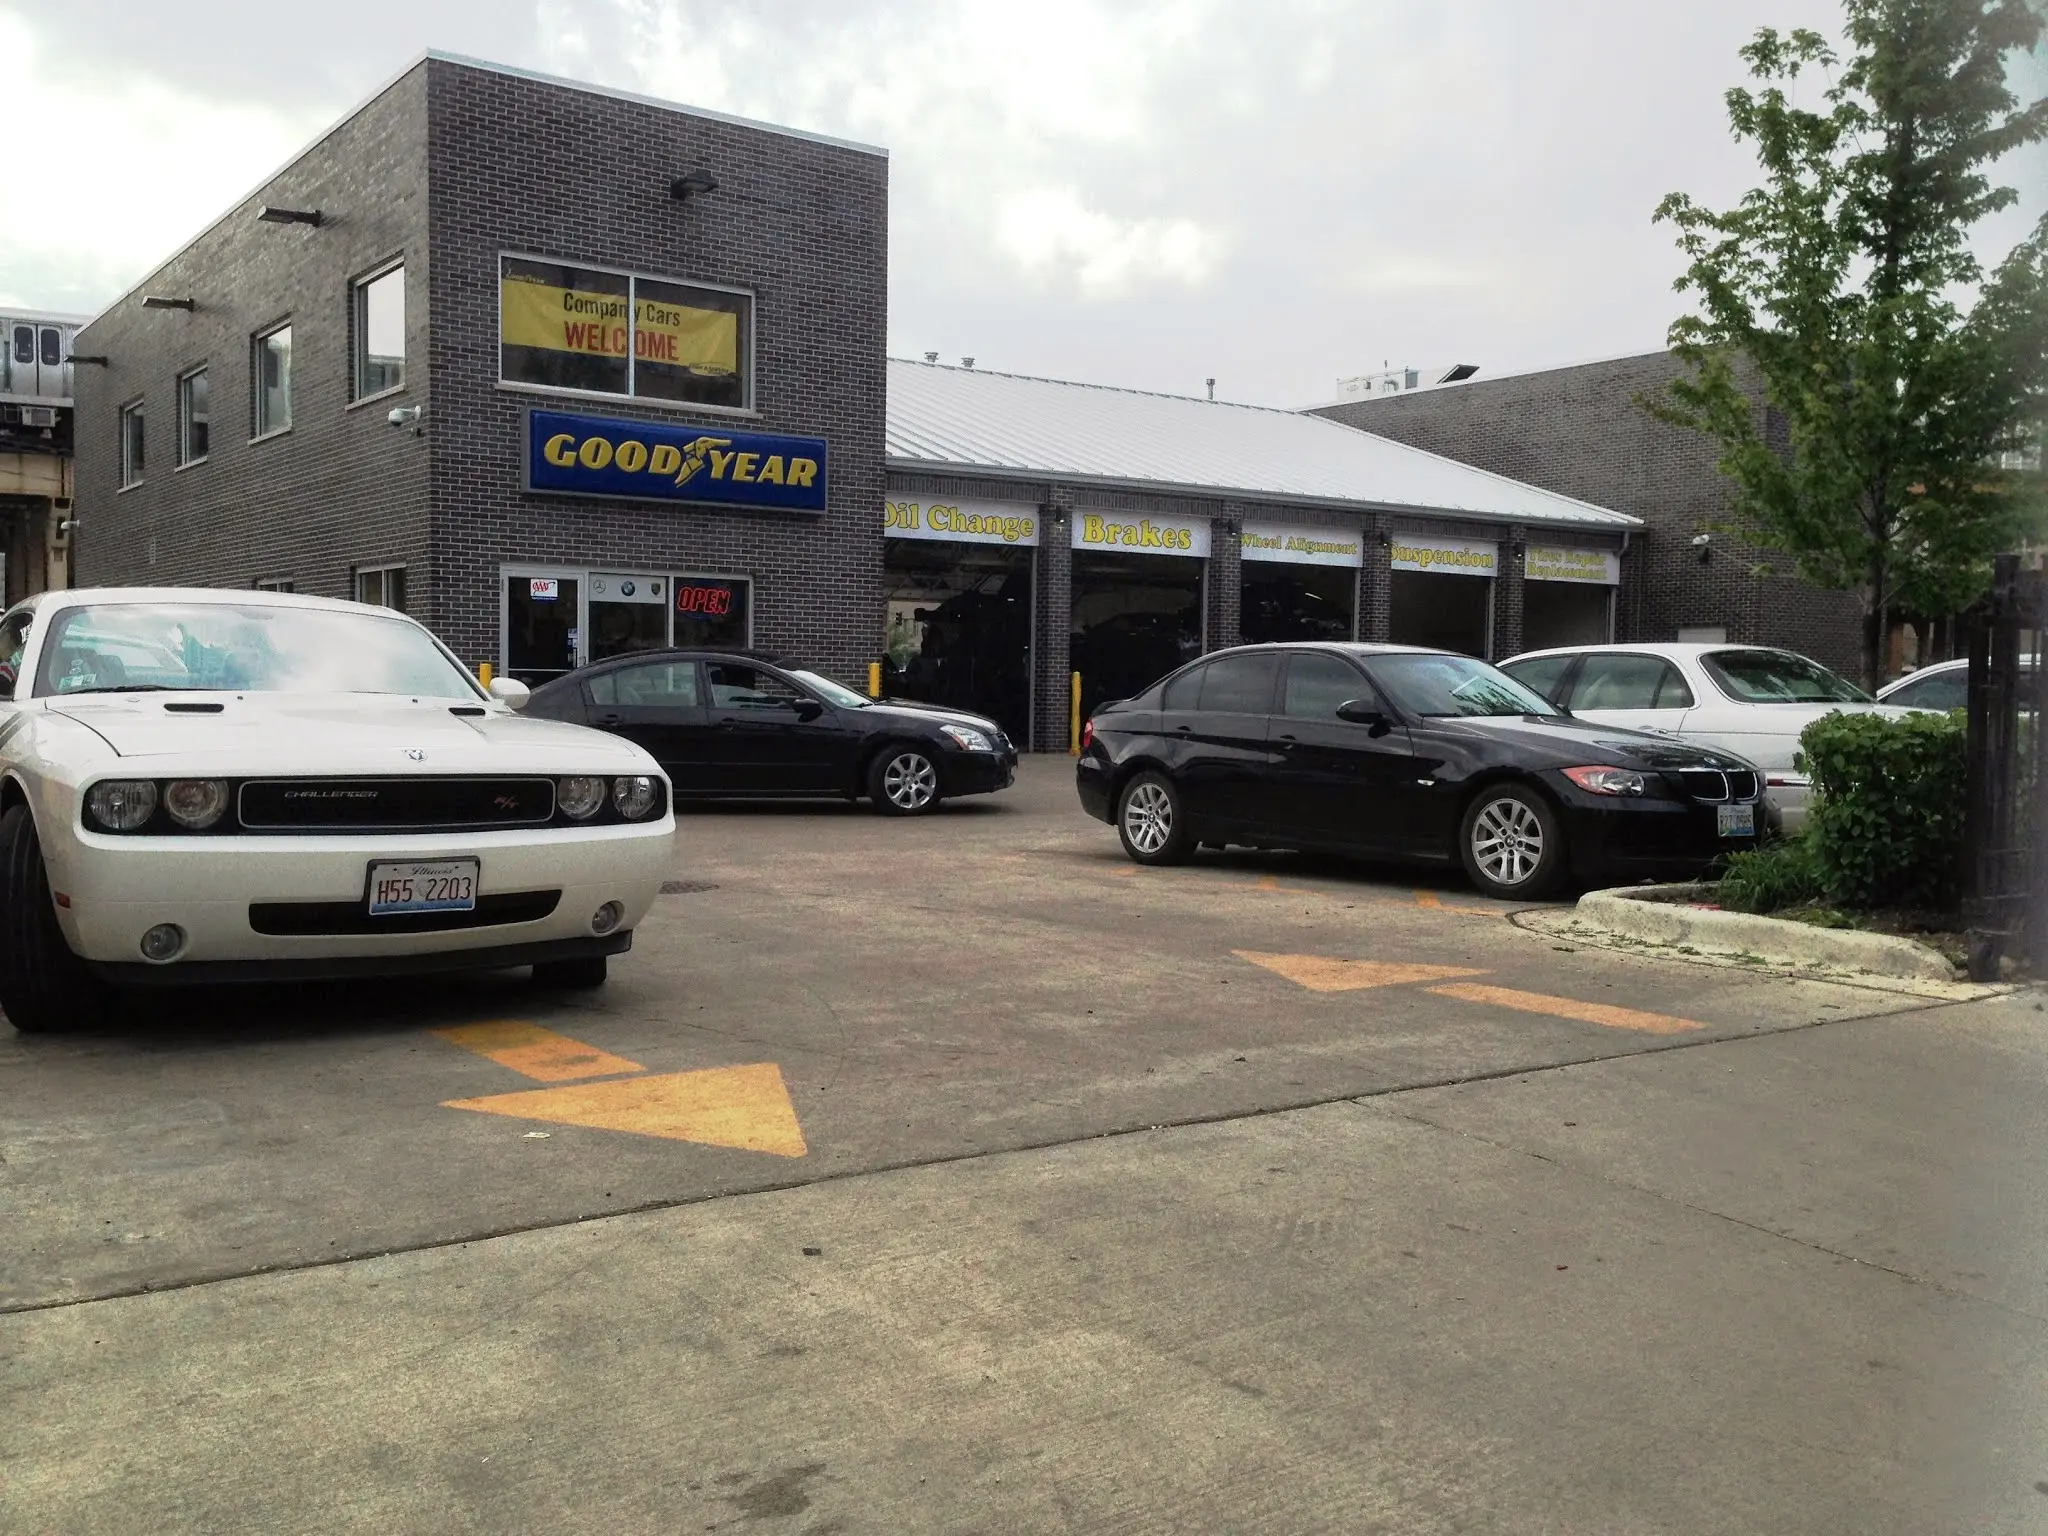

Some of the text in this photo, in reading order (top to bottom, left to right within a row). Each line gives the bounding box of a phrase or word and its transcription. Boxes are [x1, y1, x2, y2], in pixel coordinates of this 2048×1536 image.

[563, 292, 680, 327] Company Cars
[564, 320, 680, 361] WELCOME
[927, 504, 1035, 541] Change
[1083, 514, 1192, 549] Brakes
[1240, 532, 1358, 555] Wheel Alignment
[1391, 541, 1494, 568] Suspension
[677, 586, 732, 615] OPEN
[284, 790, 379, 798] CHALLENGER
[377, 877, 472, 905] H55 2203
